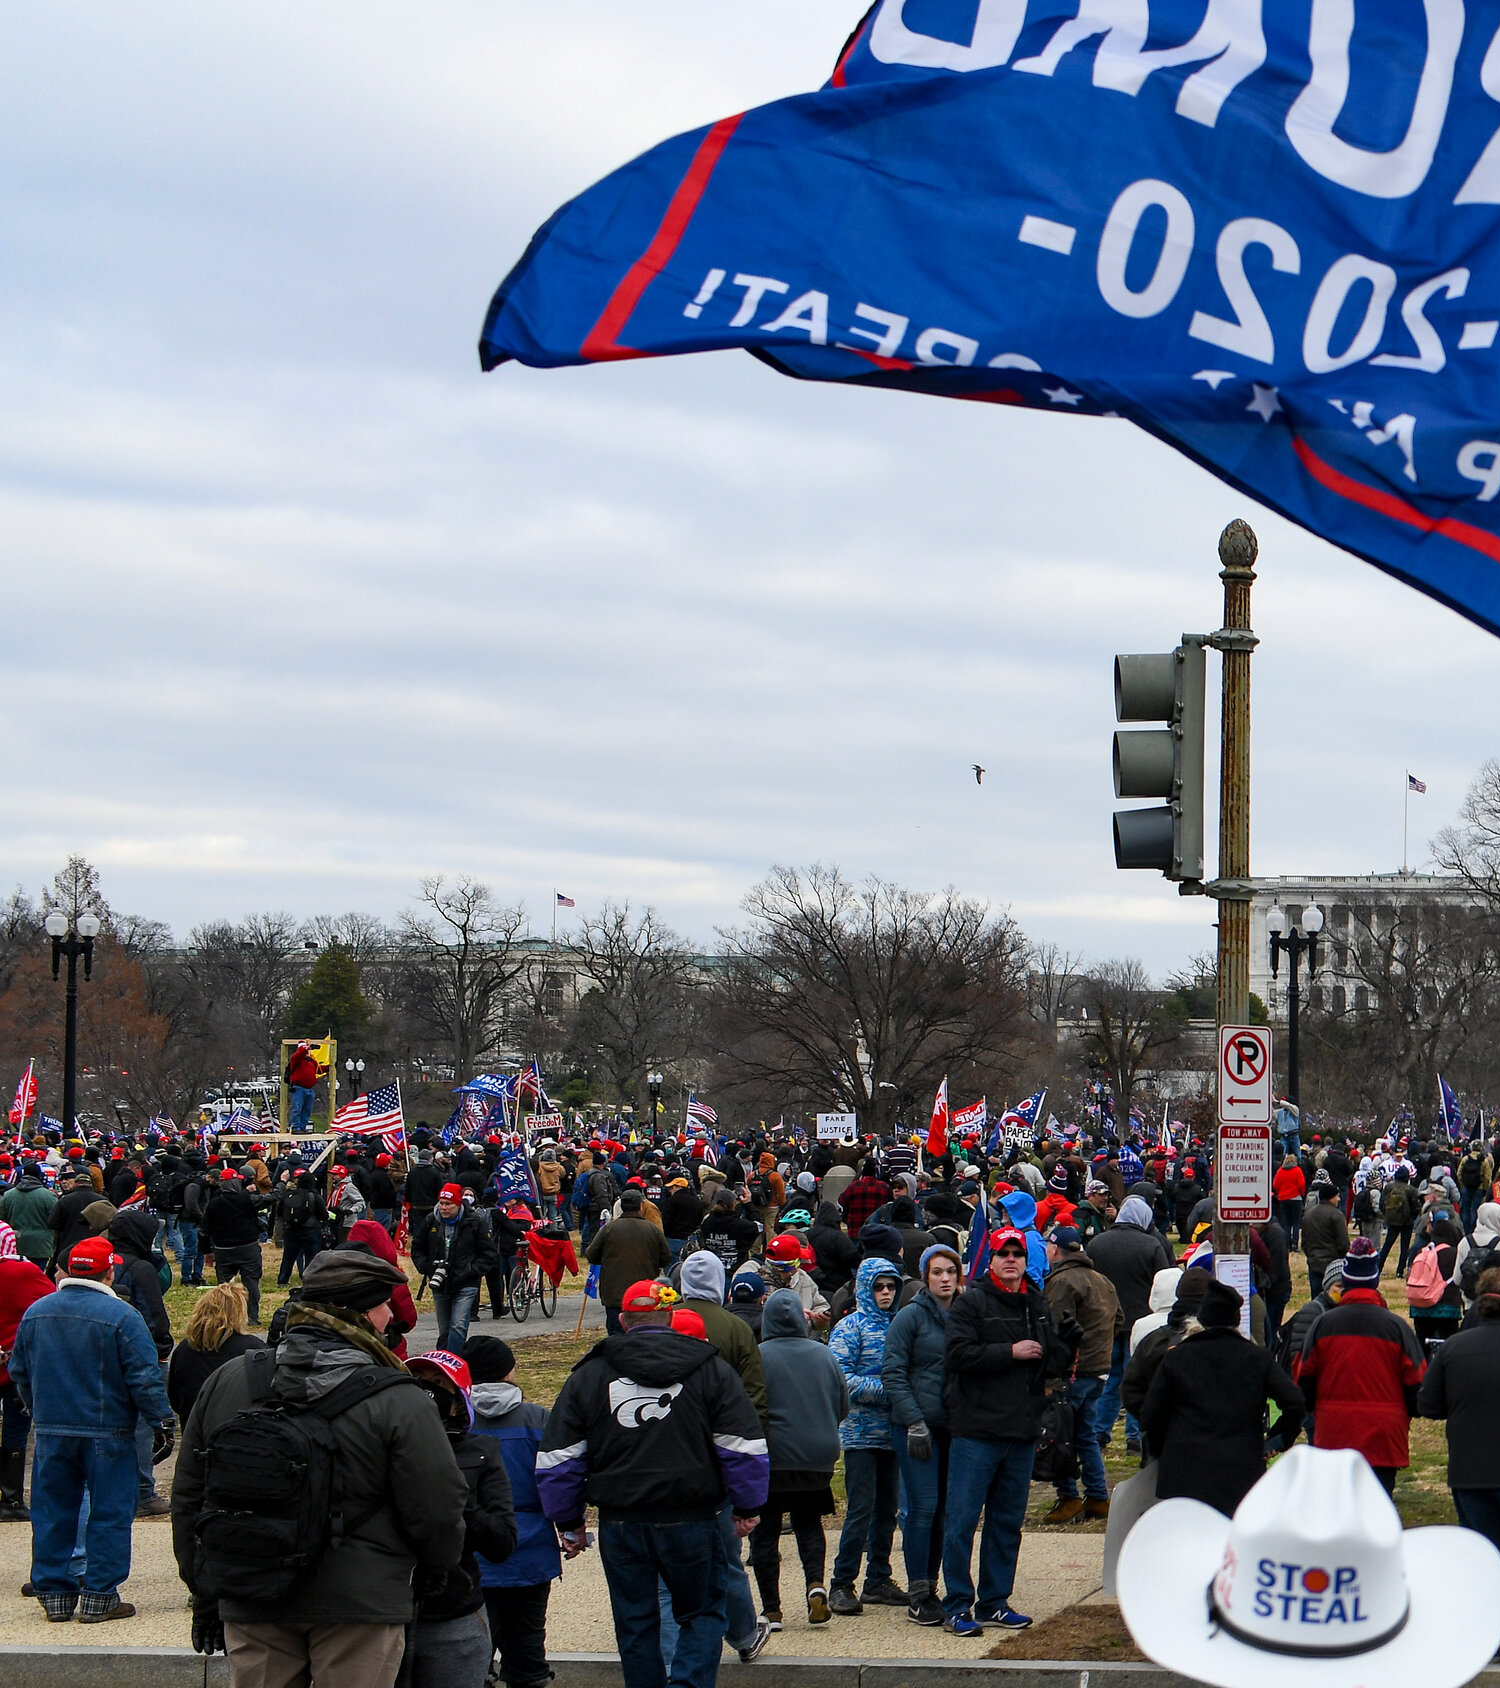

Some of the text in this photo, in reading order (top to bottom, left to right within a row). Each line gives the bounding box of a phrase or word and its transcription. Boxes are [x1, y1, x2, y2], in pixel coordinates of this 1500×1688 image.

[819, 1126, 853, 1134] JUSTICE
[1006, 1126, 1034, 1140] PAPER
[1227, 1128, 1262, 1137] TOW AWAY
[1225, 1142, 1265, 1151] NO STANDING
[1225, 1153, 1265, 1161] OR PARKING
[1225, 1164, 1264, 1172] CIRCULATOR
[1223, 1210, 1228, 1218] IF
[1229, 1210, 1244, 1218] TOWED
[1245, 1210, 1258, 1218] CALL
[1254, 1589, 1368, 1623] STEAL
